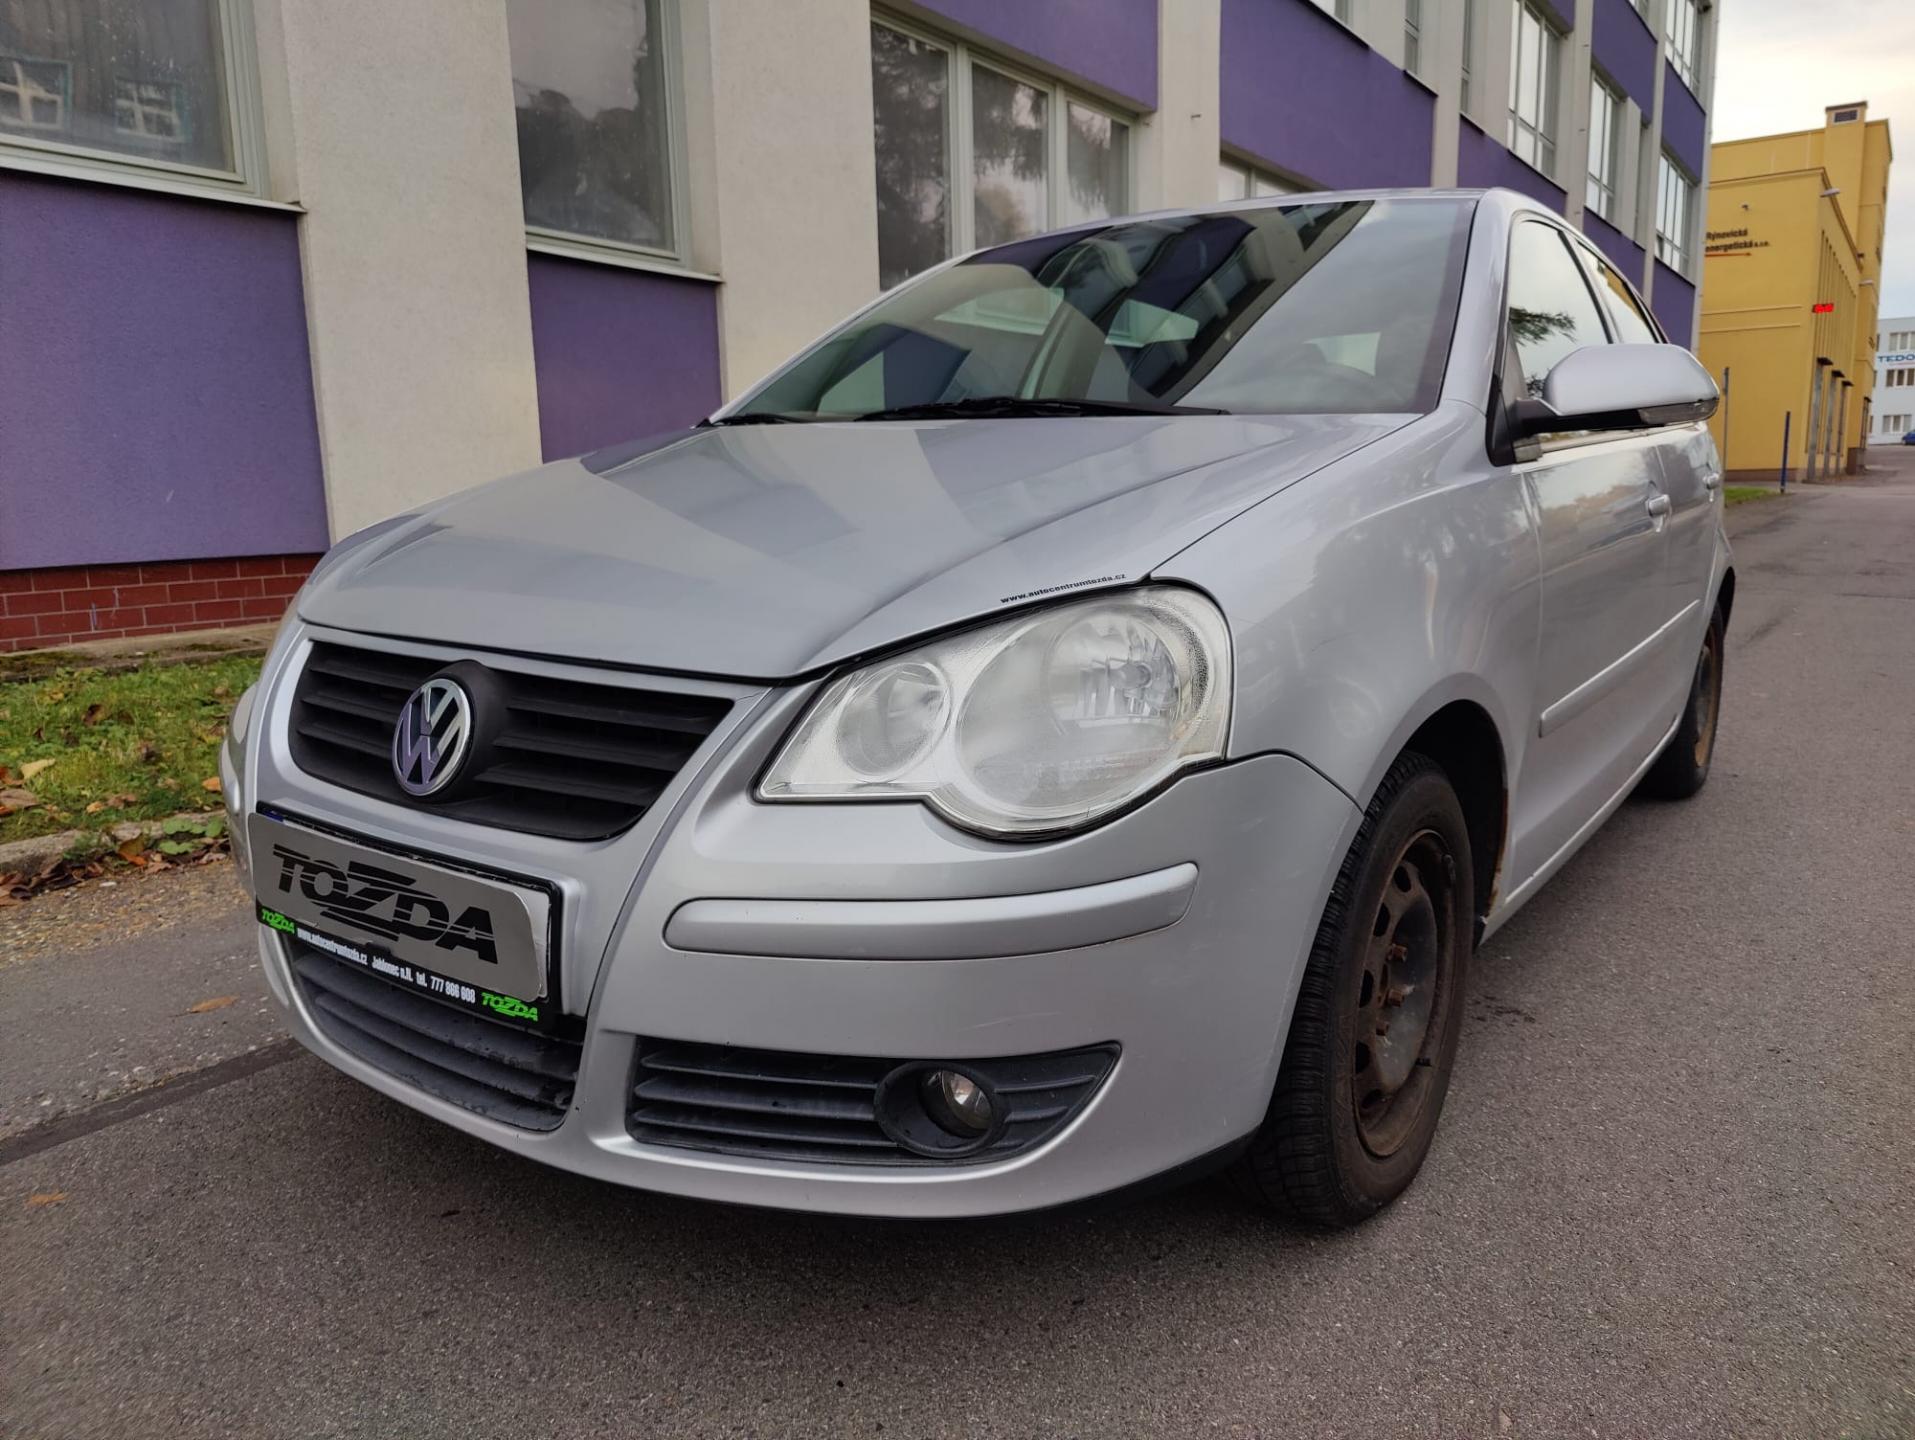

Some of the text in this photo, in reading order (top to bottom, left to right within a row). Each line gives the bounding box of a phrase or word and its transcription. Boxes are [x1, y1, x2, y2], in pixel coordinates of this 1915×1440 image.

[1000, 573, 1127, 603] www.autocentrumtozda.cz
[272, 843, 498, 965] TOZDA
[261, 908, 296, 934] TOZDA
[416, 971, 427, 988] tel.
[430, 975, 444, 993] 777
[481, 992, 539, 1022] TOZDA
